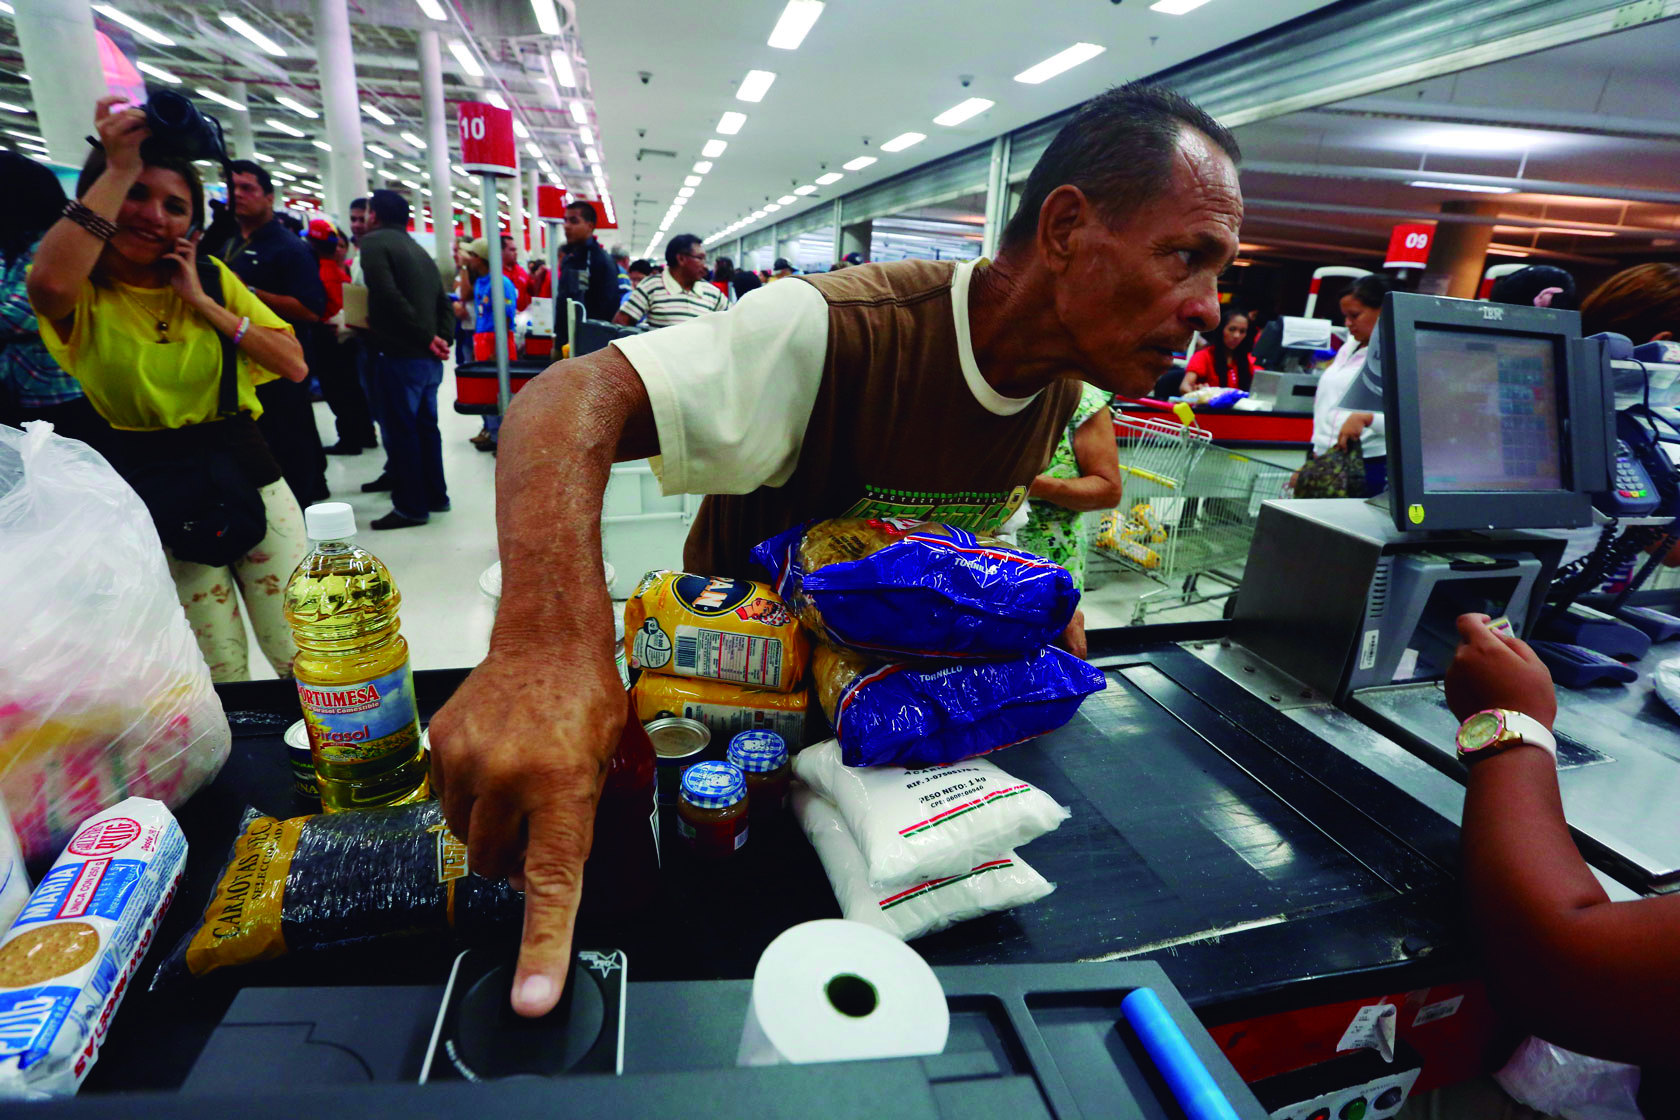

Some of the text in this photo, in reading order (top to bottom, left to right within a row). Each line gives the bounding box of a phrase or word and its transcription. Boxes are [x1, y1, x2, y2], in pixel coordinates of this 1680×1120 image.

[460, 116, 485, 140] 10
[1405, 233, 1428, 249] 09
[1481, 306, 1504, 321] IBM
[919, 665, 963, 682] TORNILLO
[308, 724, 370, 742] Girasol
[919, 792, 941, 804] PESO
[941, 783, 968, 795] NETO:
[94, 823, 135, 849] PUIG
[252, 821, 285, 900] SELECCIOADA
[20, 866, 78, 921] MARIA
[69, 894, 86, 913] UNICA
[80, 877, 94, 892] CON
[213, 854, 260, 939] CARAOTAS
